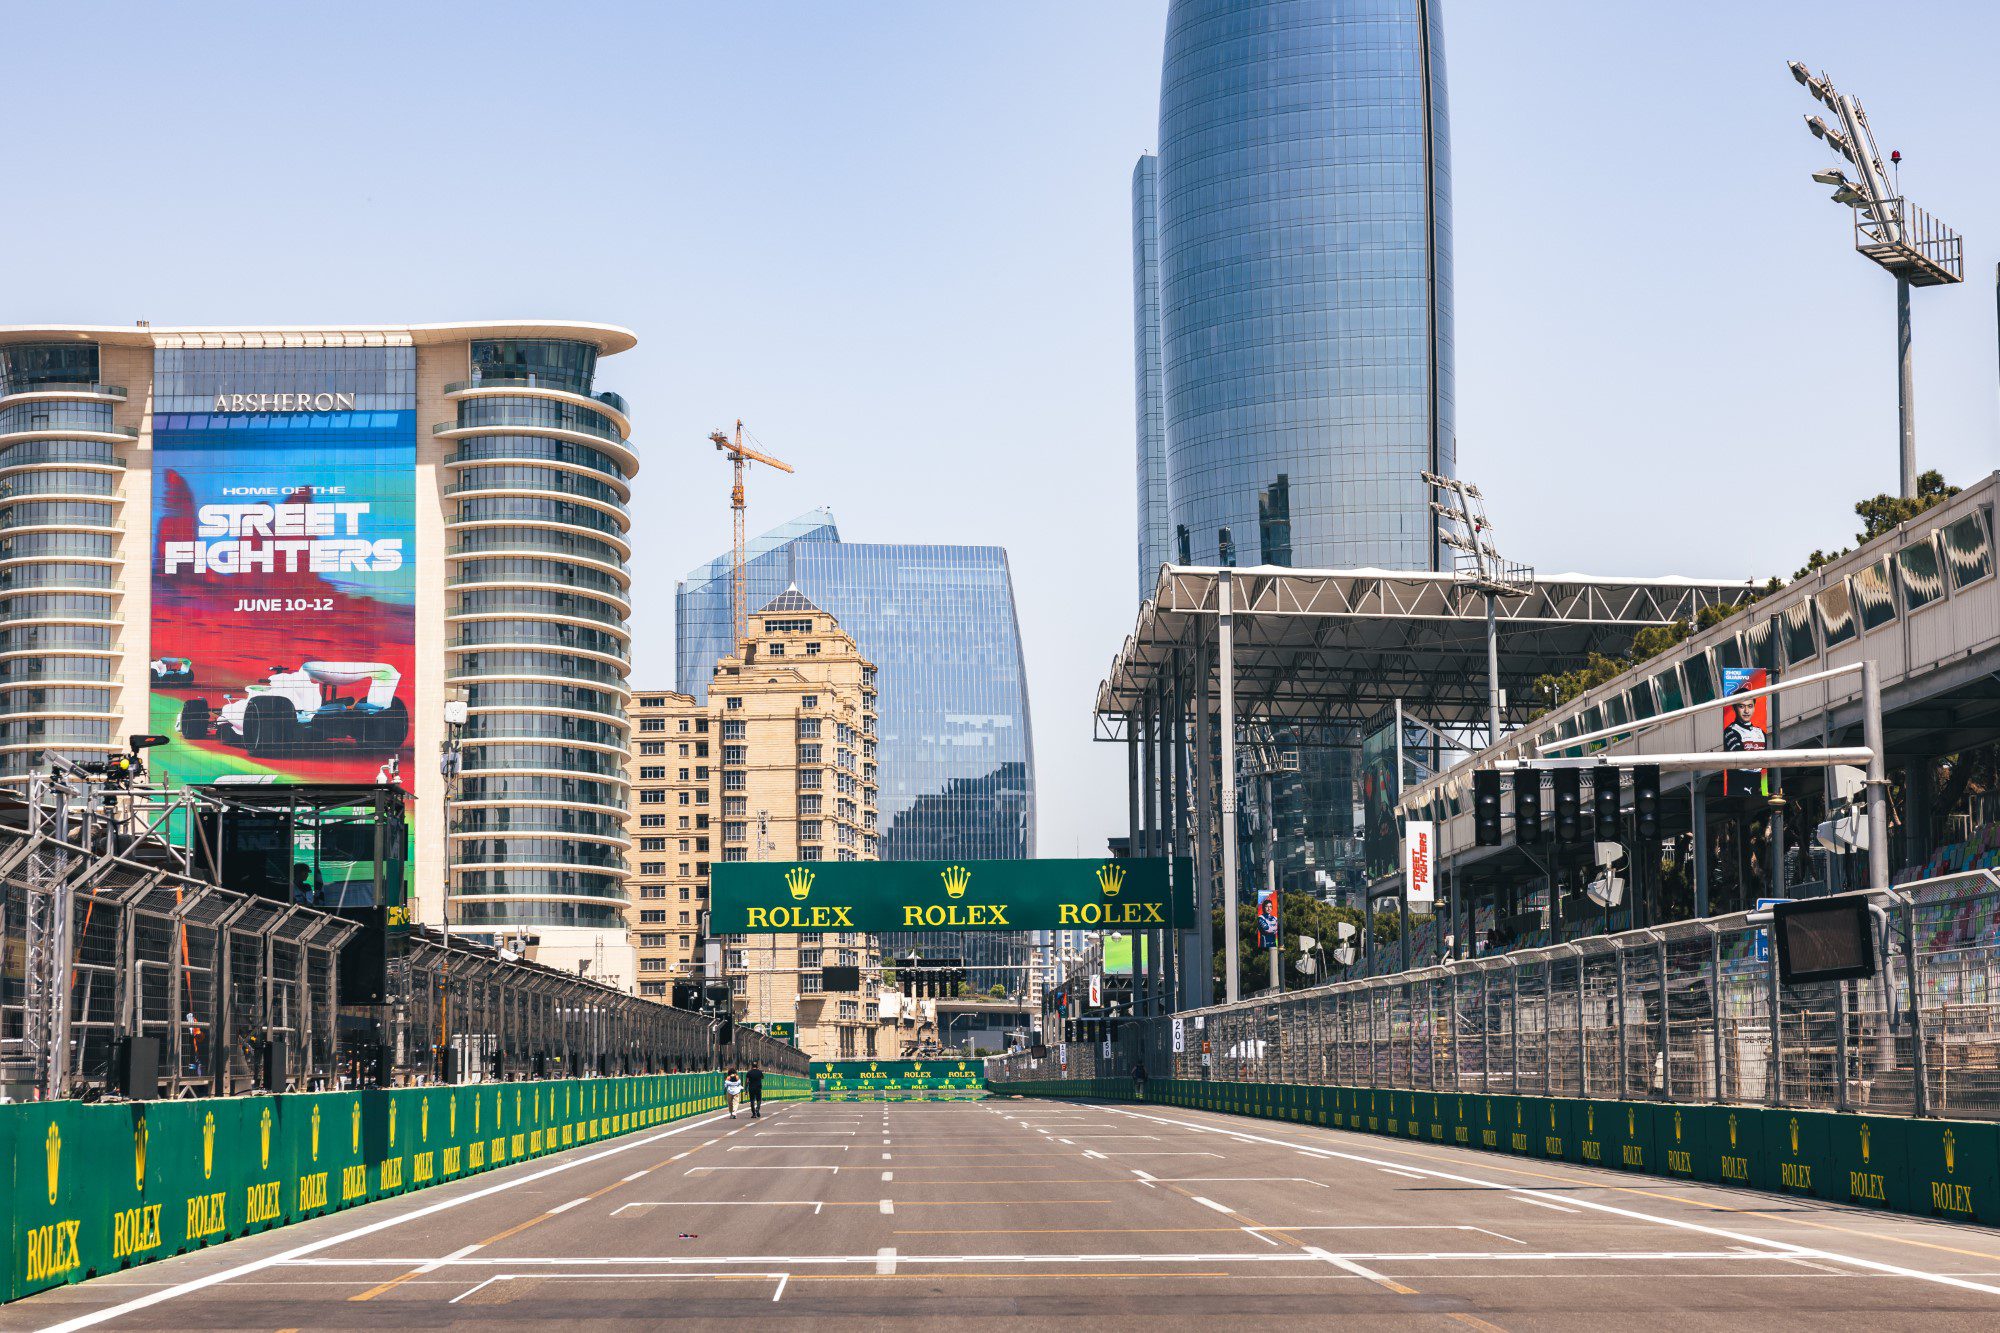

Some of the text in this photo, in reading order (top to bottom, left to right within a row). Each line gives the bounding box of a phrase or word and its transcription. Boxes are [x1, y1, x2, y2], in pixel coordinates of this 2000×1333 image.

[214, 393, 356, 412] ABSHERON
[223, 486, 346, 496] HOME OF THE
[198, 502, 370, 537] STREET
[164, 538, 403, 575] FIGHTERS
[234, 598, 334, 612] JUNE 10-12
[1412, 848, 1421, 891] STREET
[1419, 832, 1428, 884] FIGHTERS
[746, 906, 854, 928] ROLEX
[903, 905, 1010, 926] ROLEX
[1059, 903, 1165, 924] ROLEX
[1546, 1136, 1563, 1155] ROLEX
[1582, 1141, 1601, 1160] ROLEX
[1623, 1145, 1643, 1165] ROLEX
[380, 1157, 403, 1190] ROLEX
[413, 1151, 434, 1182] ROLEX
[1668, 1150, 1692, 1172] ROLEX
[1721, 1156, 1747, 1179] ROLEX
[342, 1164, 367, 1200] ROLEX
[1781, 1163, 1811, 1189] ROLEX
[1850, 1172, 1886, 1200] ROLEX
[246, 1181, 281, 1223] ROLEX
[300, 1172, 328, 1211] ROLEX
[1931, 1182, 1973, 1213] ROLEX
[186, 1192, 226, 1239] ROLEX
[113, 1203, 162, 1258] ROLEX
[26, 1219, 80, 1281] ROLEX
